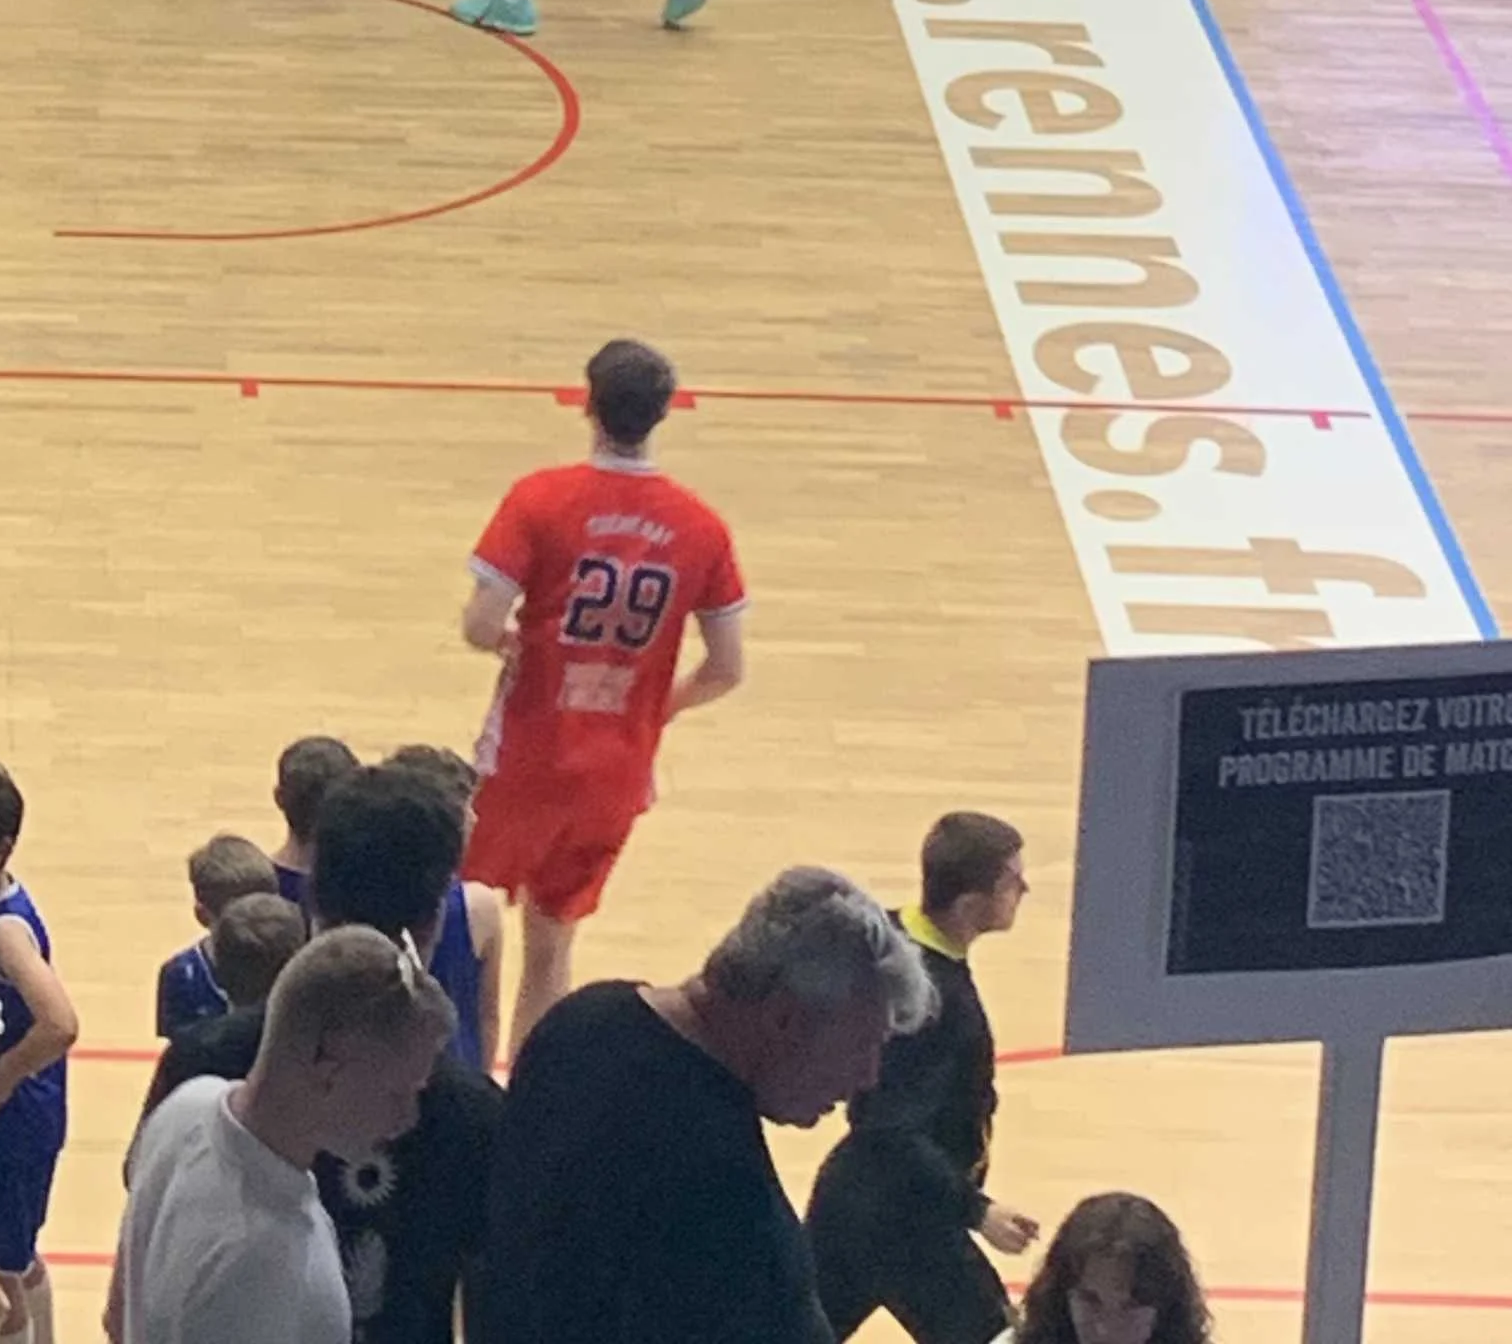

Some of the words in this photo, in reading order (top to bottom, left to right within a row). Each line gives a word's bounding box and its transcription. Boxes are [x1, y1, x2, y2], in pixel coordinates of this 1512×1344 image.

[559, 554, 679, 654] 29
[1241, 697, 1430, 741] TÉLÉCHARGEZ
[1218, 745, 1394, 788] PROGRAMME
[1403, 743, 1439, 778] DE
